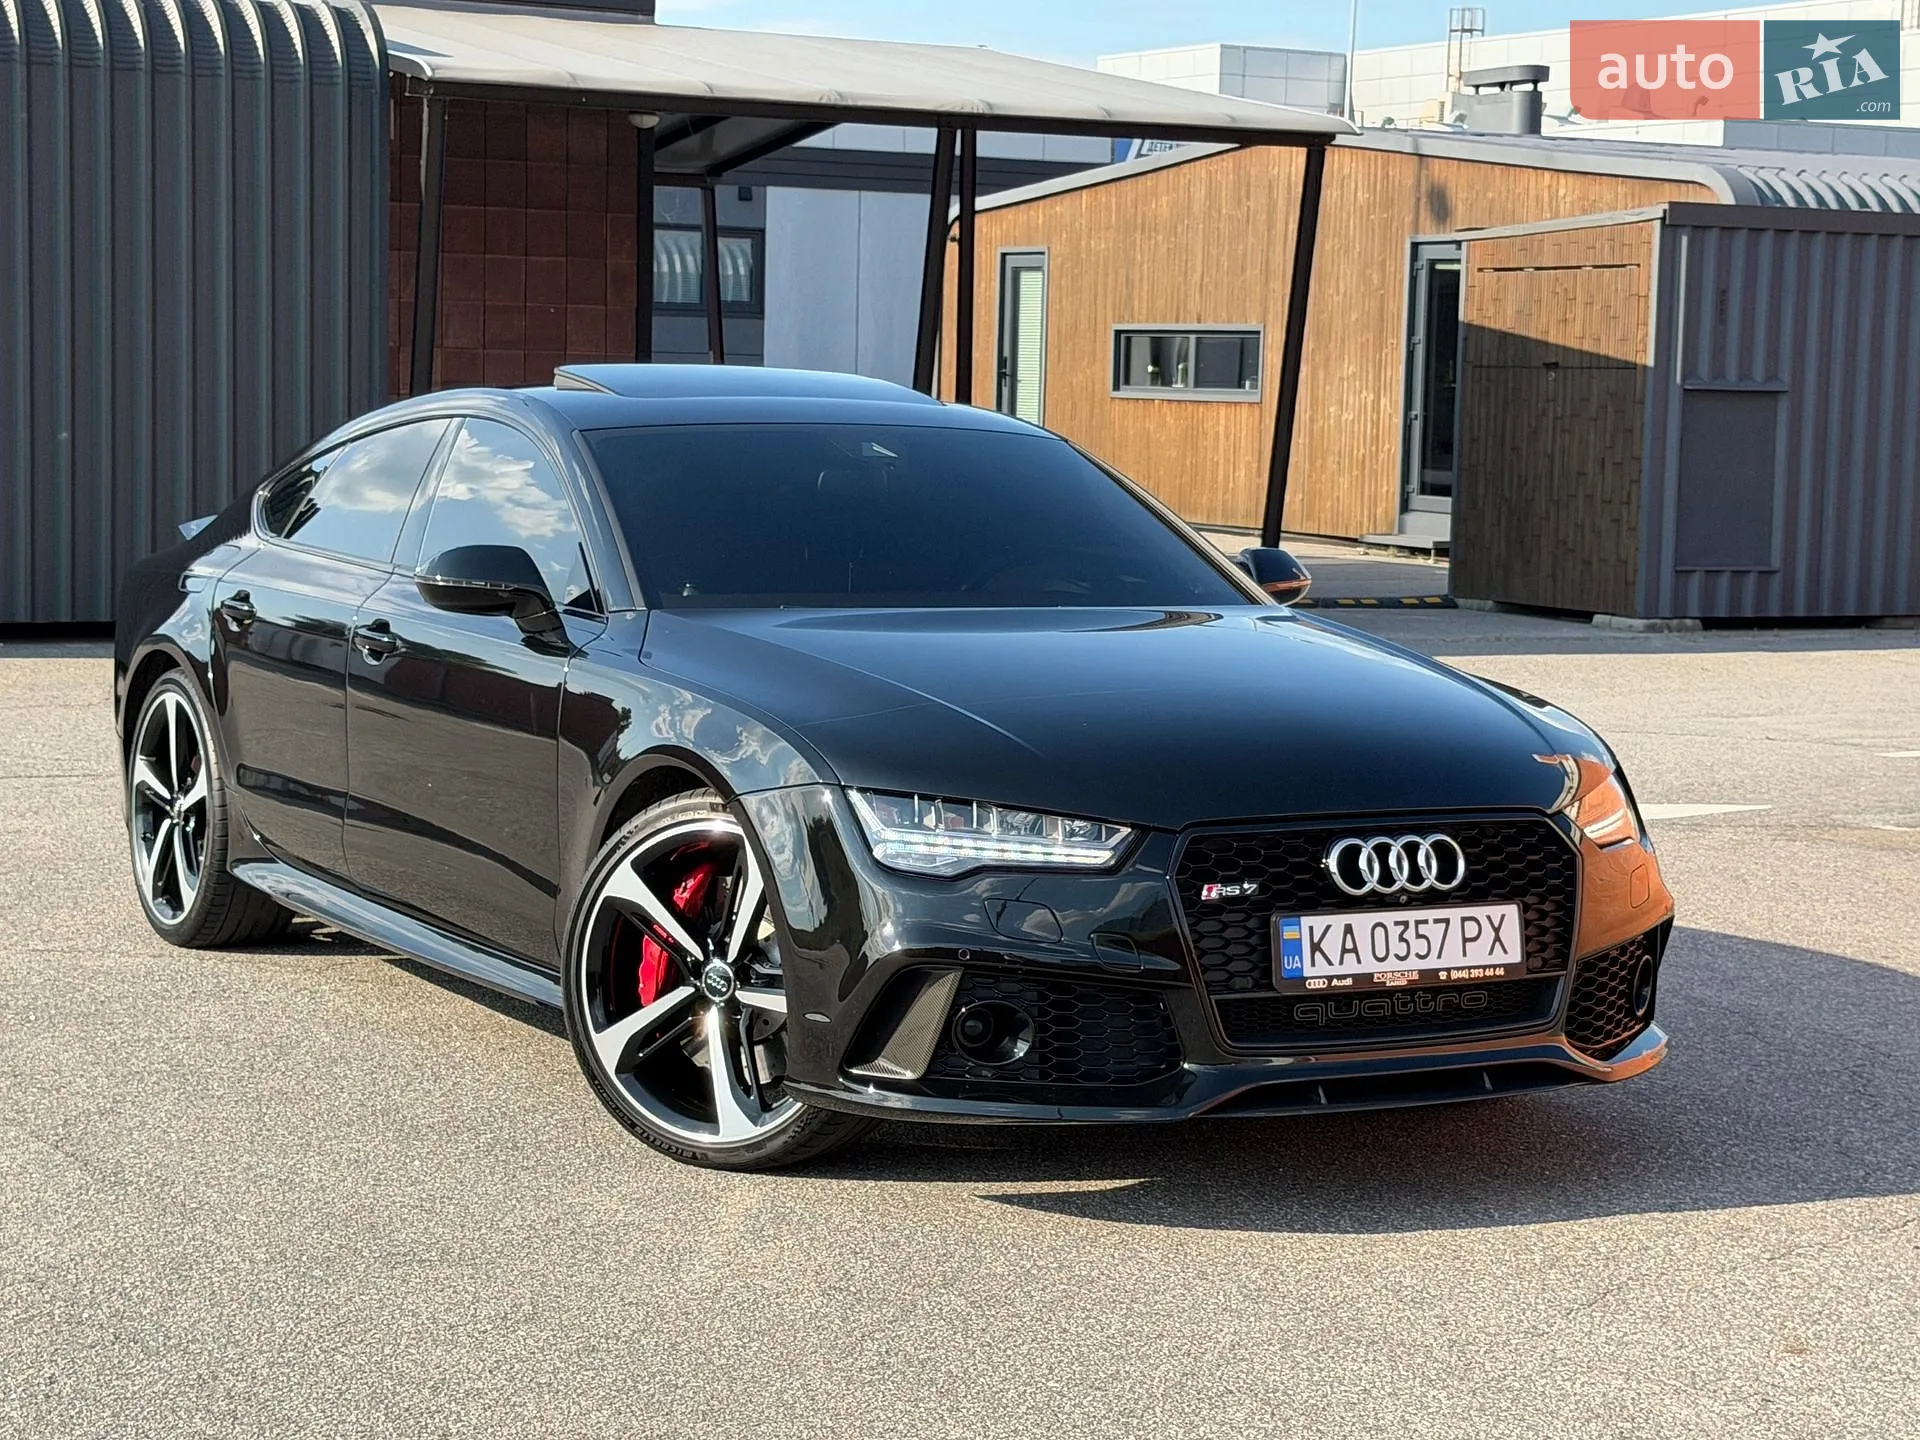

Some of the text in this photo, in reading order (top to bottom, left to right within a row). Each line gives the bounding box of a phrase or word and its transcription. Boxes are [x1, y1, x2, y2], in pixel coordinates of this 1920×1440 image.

[1307, 913, 1509, 968] KA 0357 PX
[1284, 955, 1302, 970] UA
[1331, 977, 1353, 987] Audi
[1373, 970, 1420, 983] PORSCHE
[1293, 990, 1488, 1026] quattro
